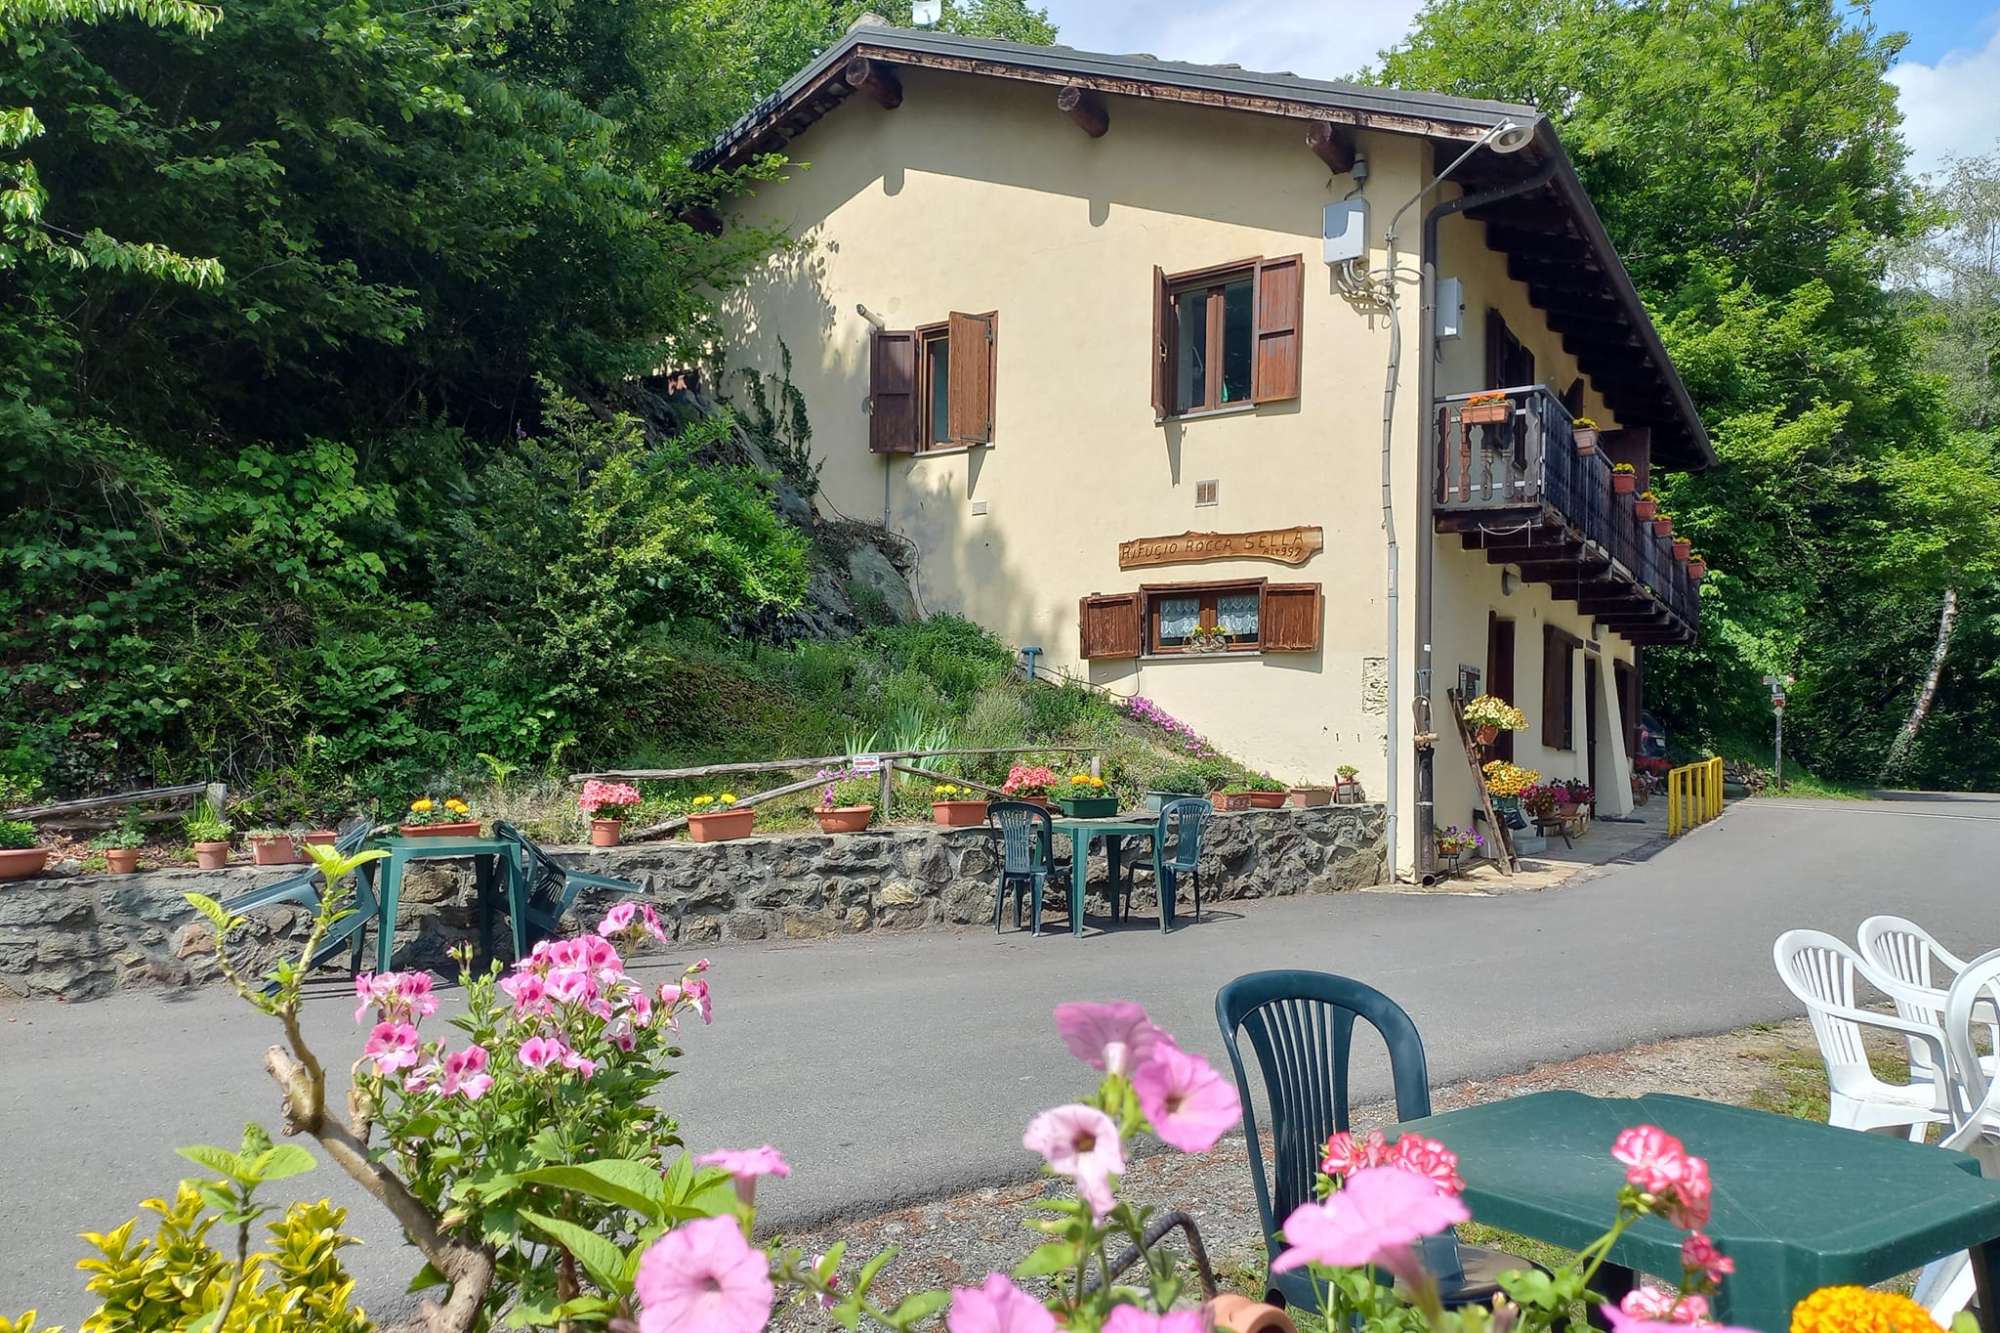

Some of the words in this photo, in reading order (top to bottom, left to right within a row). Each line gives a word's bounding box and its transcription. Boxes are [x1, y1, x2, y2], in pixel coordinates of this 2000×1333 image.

[1121, 543, 1178, 560] RIFUGIO
[1185, 539, 1232, 552] ROCCA
[1244, 531, 1303, 549] SELLA
